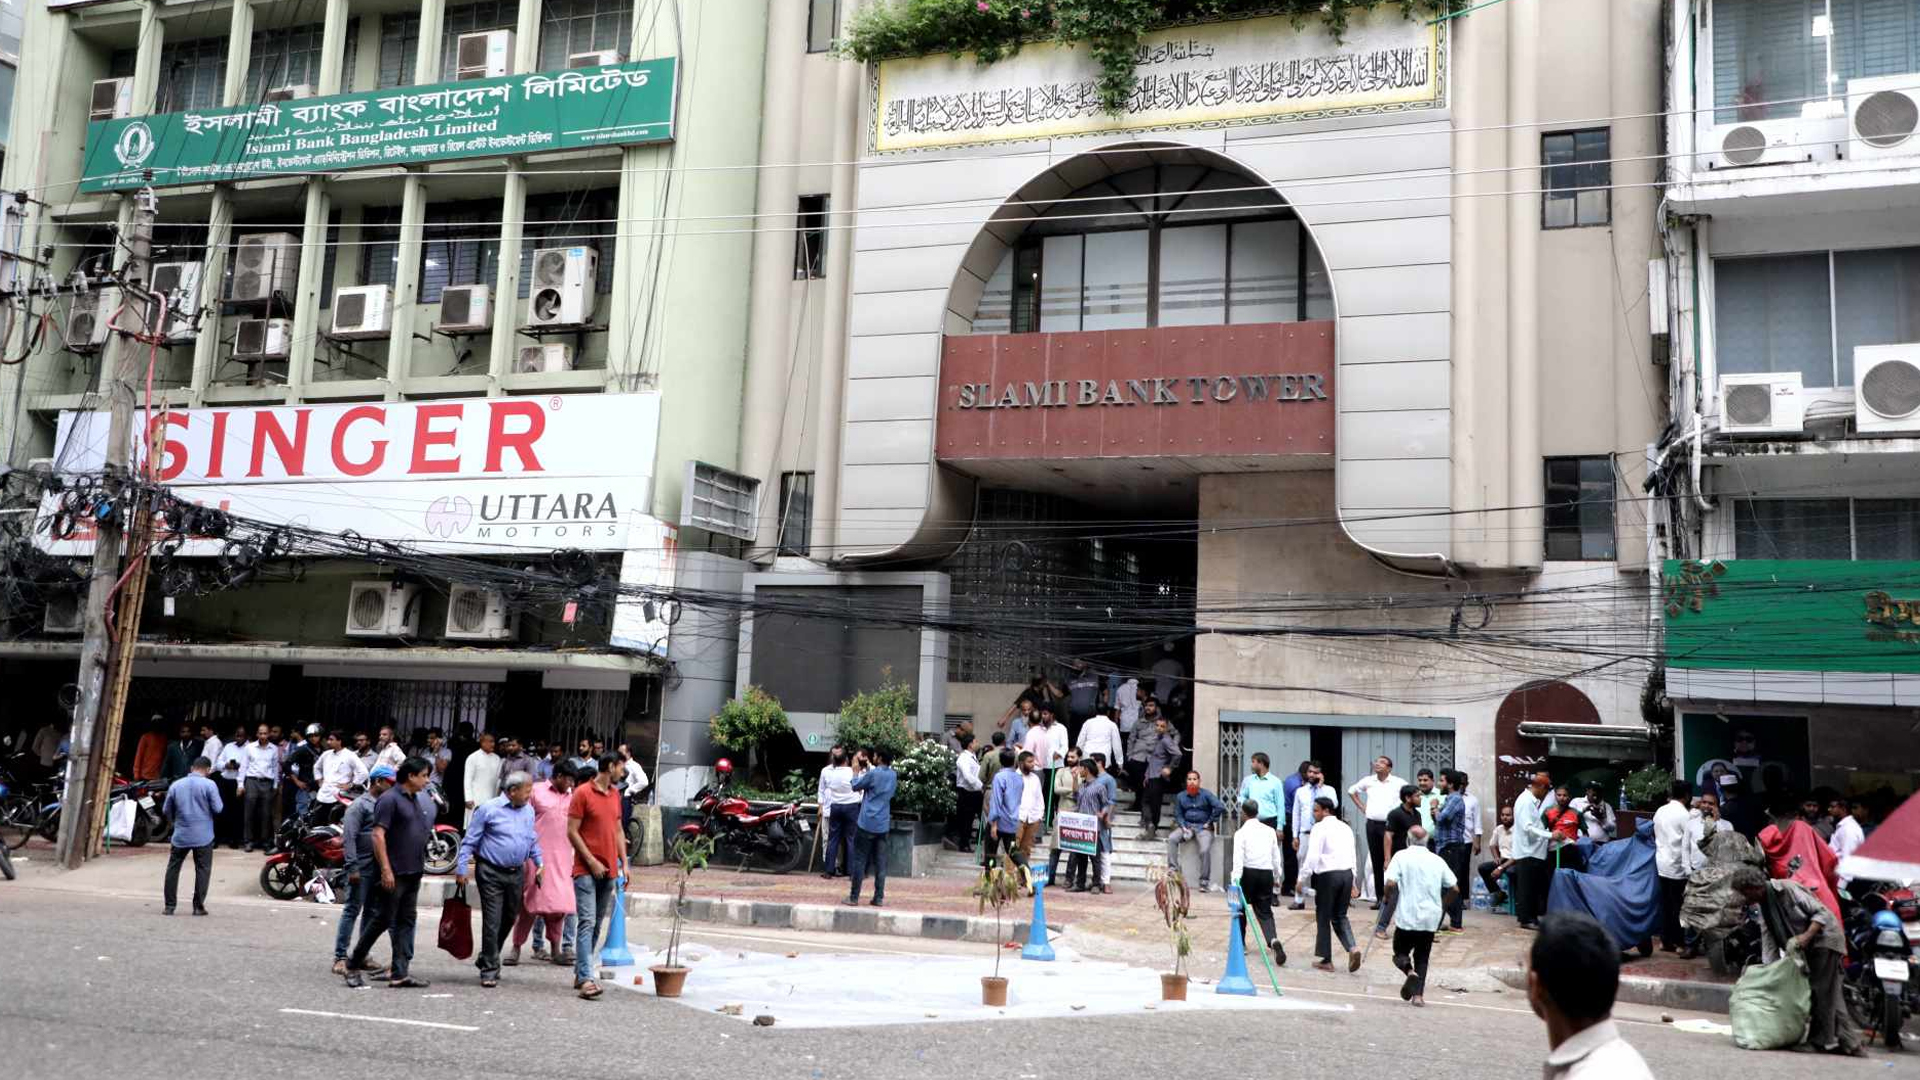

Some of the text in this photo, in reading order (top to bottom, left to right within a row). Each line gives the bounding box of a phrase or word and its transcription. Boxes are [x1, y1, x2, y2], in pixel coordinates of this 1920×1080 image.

[184, 69, 651, 135] ইসলামী ব্যাংক বাংলাদেশ লিমিটেড
[245, 119, 497, 155] Islami Bank Bangladesh Limited
[1076, 377, 1180, 407] BANK
[1186, 373, 1329, 404] TOWER
[142, 400, 546, 482] SINGER
[480, 492, 617, 521] UTTARA
[477, 525, 617, 538] MOTORS
